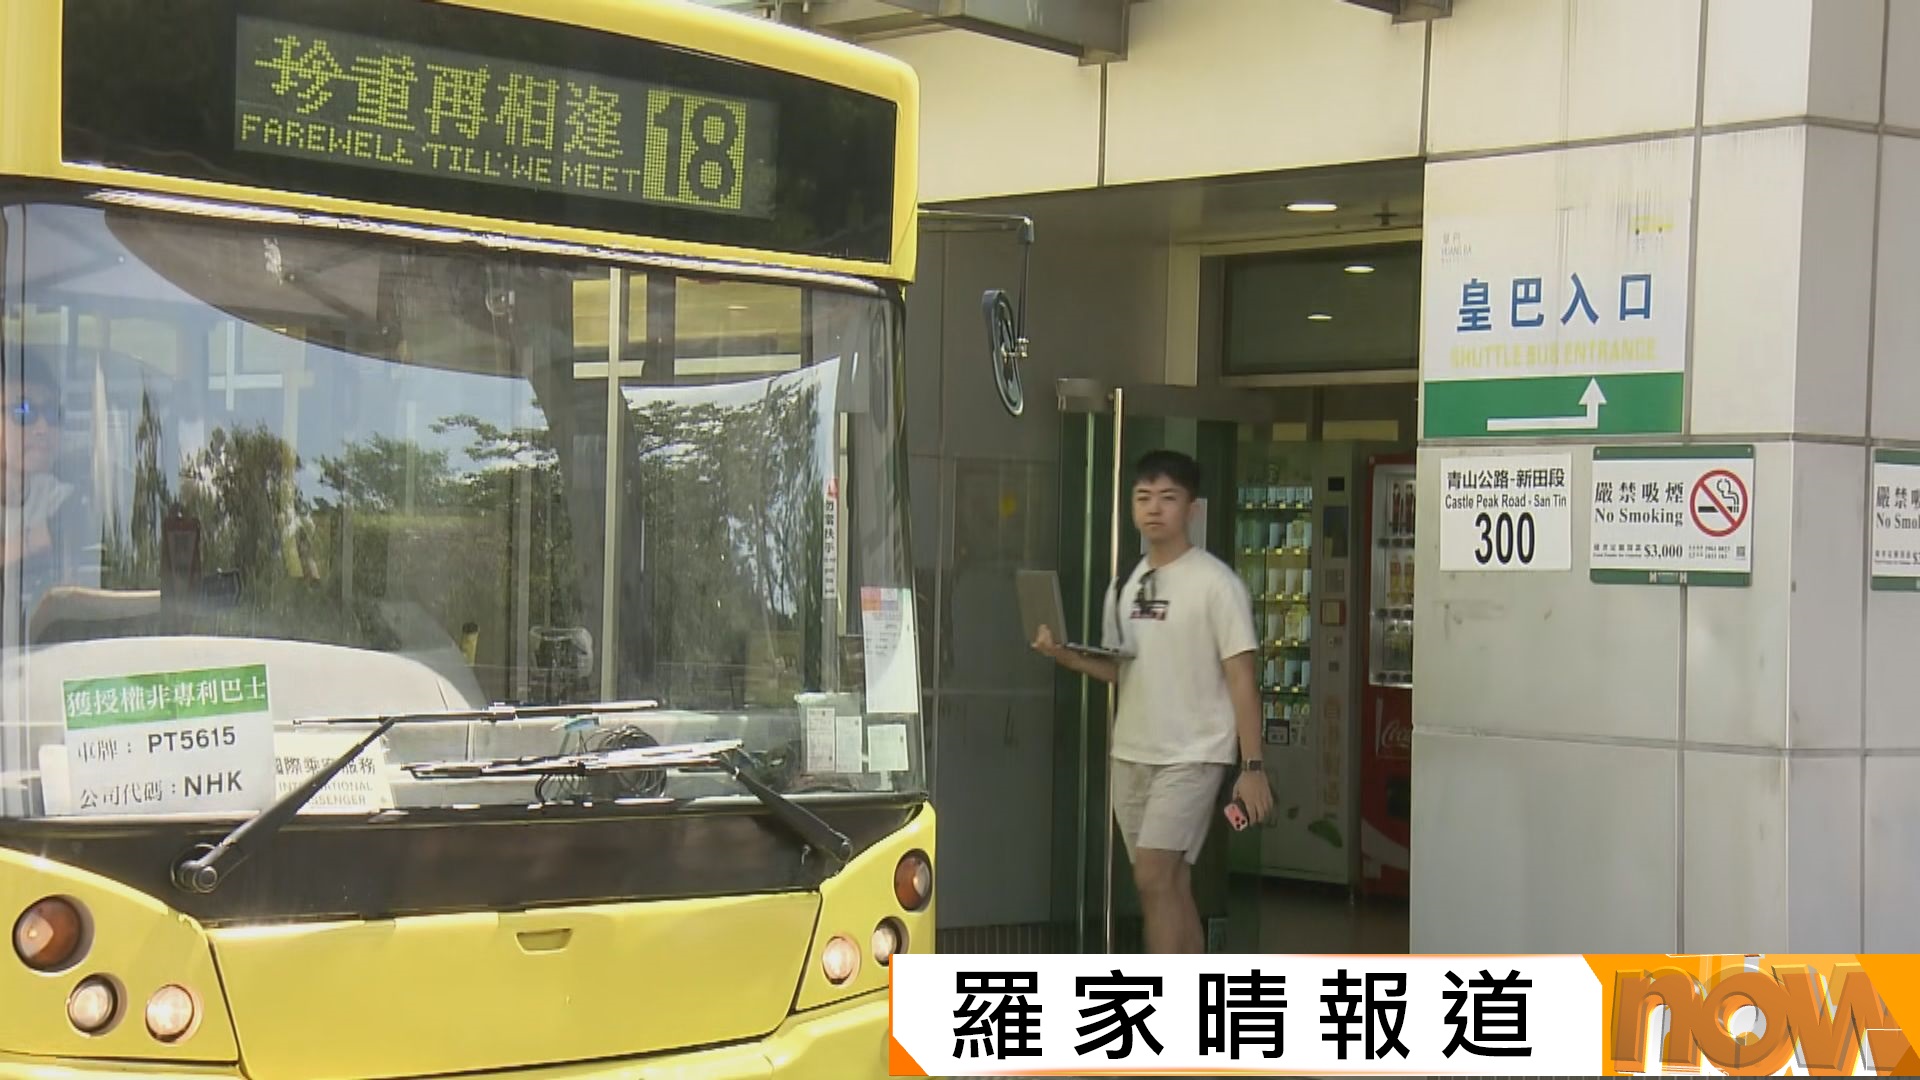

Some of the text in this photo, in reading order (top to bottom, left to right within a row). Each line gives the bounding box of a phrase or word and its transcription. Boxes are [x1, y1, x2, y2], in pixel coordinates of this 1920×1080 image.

[255, 35, 623, 158] 珍重再相逢
[241, 113, 414, 165] FAREWELL
[561, 160, 640, 192] MEET
[649, 93, 740, 205] 18
[1456, 272, 1652, 333] 皇巴入口
[1451, 343, 1521, 368] SHUTTLE
[1565, 336, 1657, 365] ENTRANCE
[1447, 468, 1565, 490] 青山公路-新田段
[1595, 481, 1684, 504] 嚴禁吸煙
[1445, 494, 1474, 509] Castle
[1476, 494, 1499, 508] Peak
[1502, 493, 1526, 508] Road
[1533, 494, 1551, 508] San
[1553, 493, 1567, 507] Tin
[1595, 506, 1684, 527] No Smoking
[1876, 512, 1891, 529] No
[1474, 512, 1535, 564] 300
[1644, 544, 1683, 560] $3,000
[67, 676, 267, 718] 獲授權非專利巴士
[148, 726, 236, 753] PT5615
[184, 771, 242, 797] NHK
